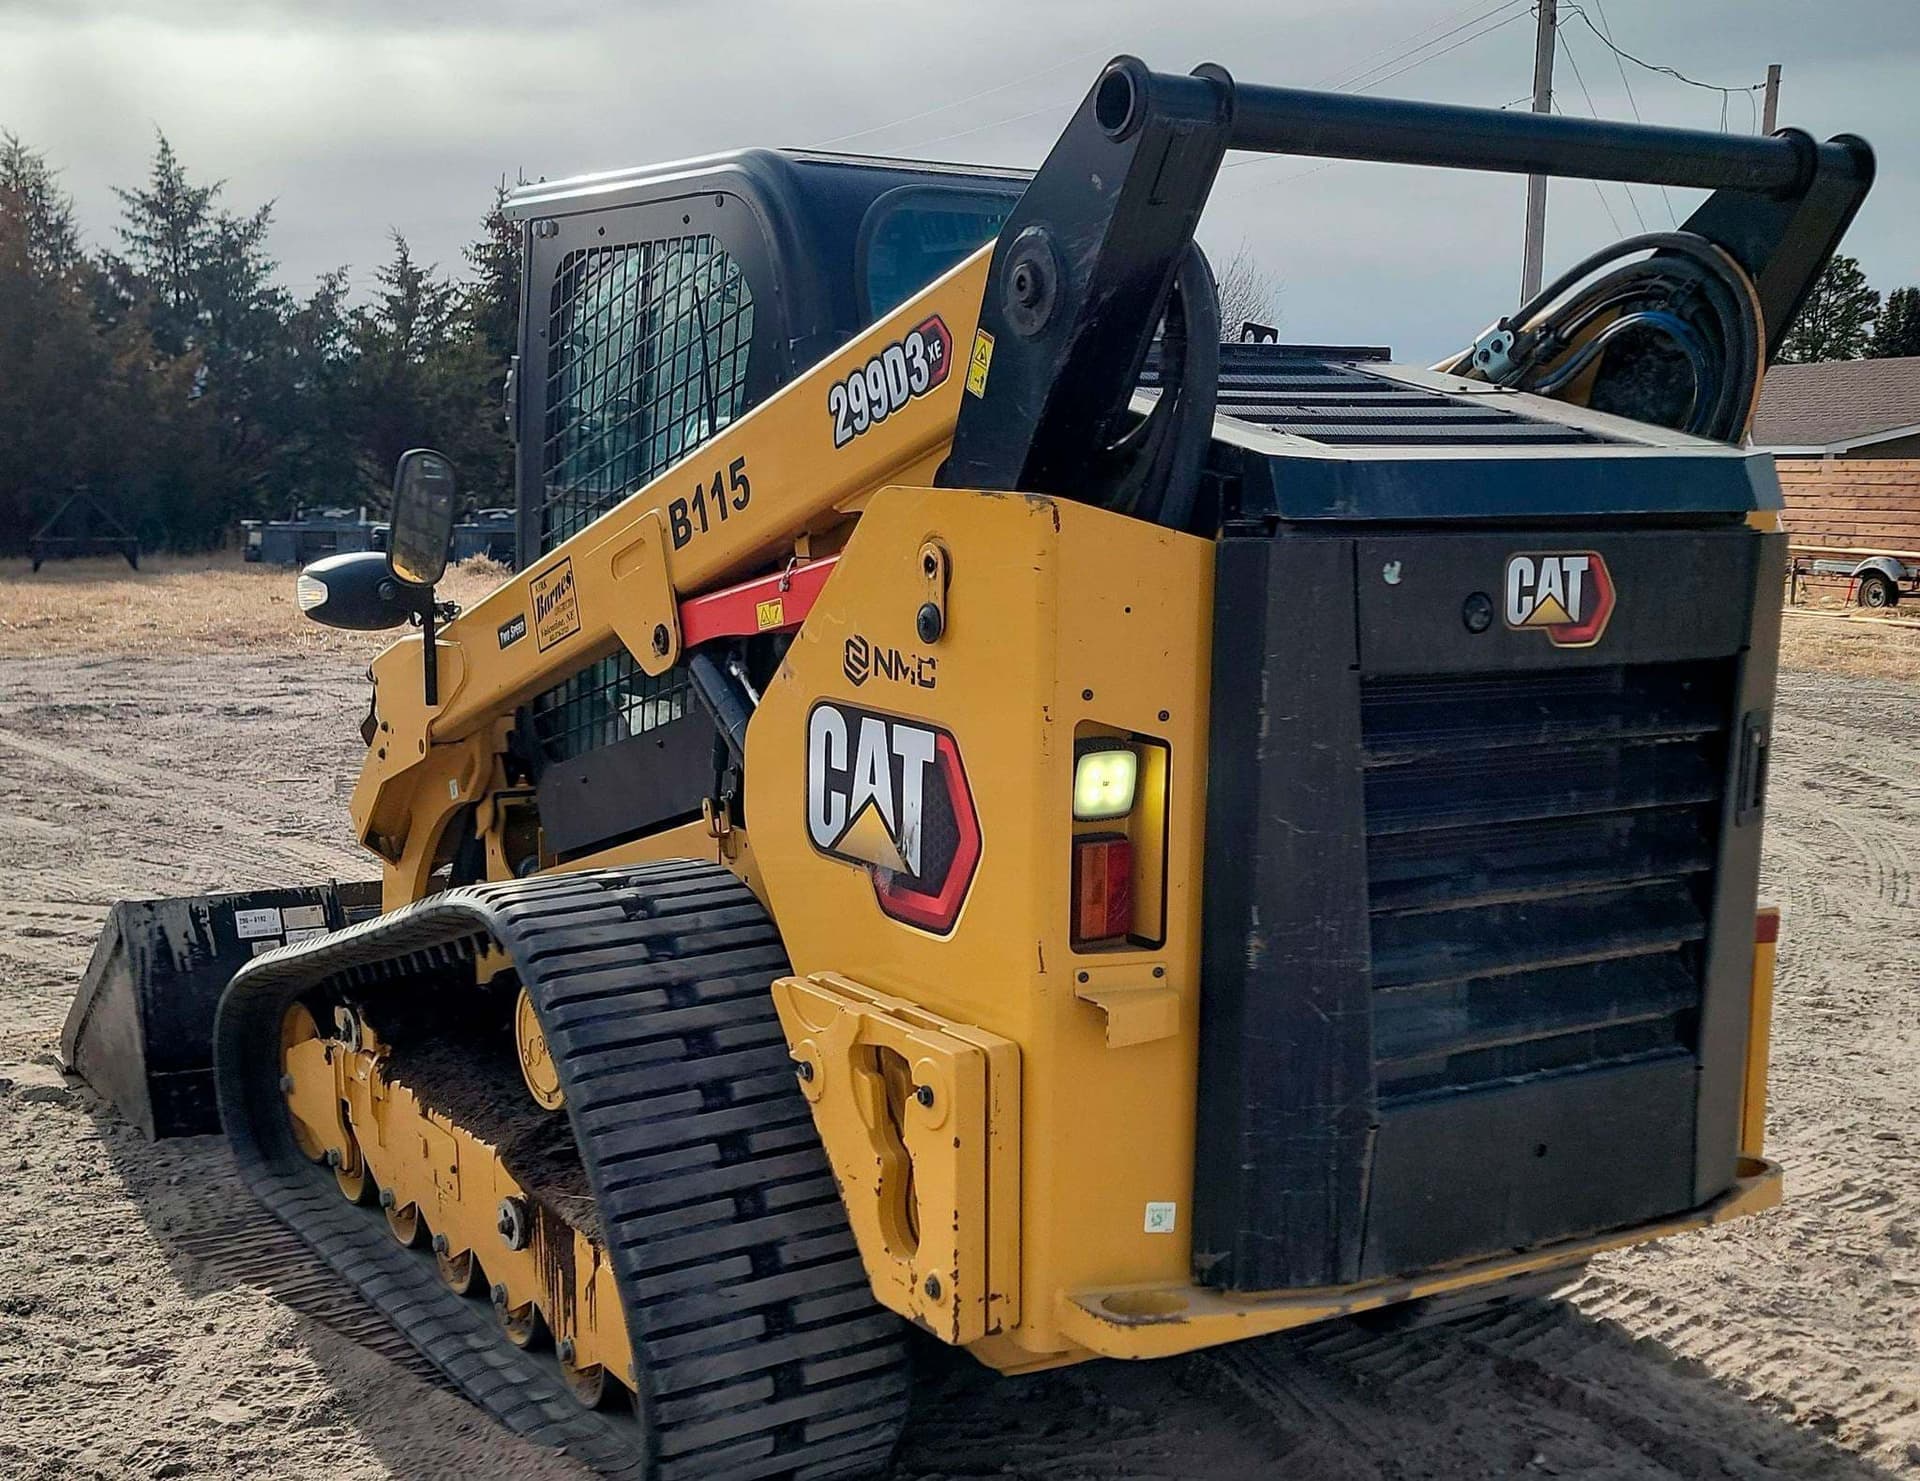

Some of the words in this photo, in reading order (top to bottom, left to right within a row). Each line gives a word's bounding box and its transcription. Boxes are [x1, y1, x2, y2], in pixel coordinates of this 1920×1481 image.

[829, 331, 930, 447] 299D3
[926, 339, 943, 364] XE
[668, 455, 751, 551] B115
[536, 570, 571, 624] Barnes
[1507, 556, 1589, 625] CAT
[873, 646, 937, 689] NMC
[809, 704, 936, 878] CAT
